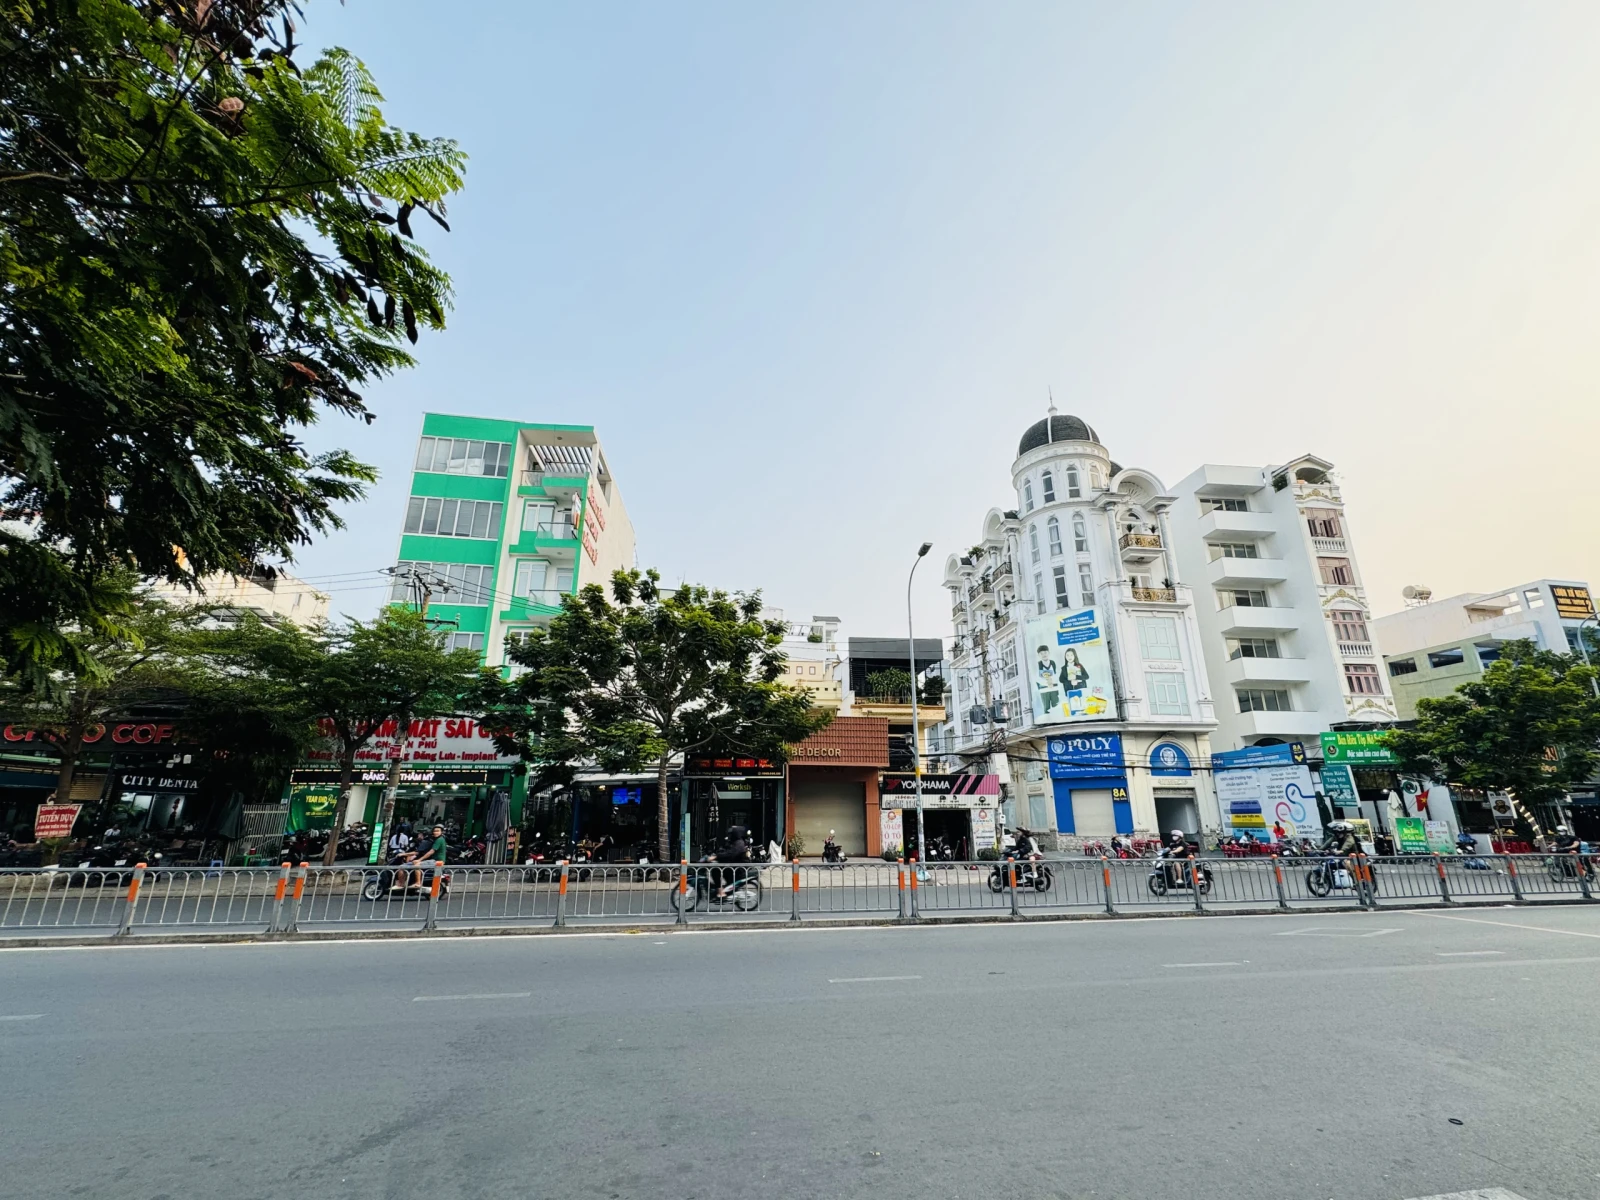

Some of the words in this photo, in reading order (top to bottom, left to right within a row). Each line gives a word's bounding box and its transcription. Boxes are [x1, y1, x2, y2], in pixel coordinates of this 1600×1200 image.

[418, 739, 438, 749] PHÚ
[1067, 737, 1113, 752] POLY
[461, 751, 498, 762] Implant
[807, 747, 841, 757] DECOR
[1347, 749, 1355, 758] Đặc
[122, 774, 154, 787] CITY
[362, 772, 385, 781] RĂNG
[1112, 788, 1126, 797] 8A
